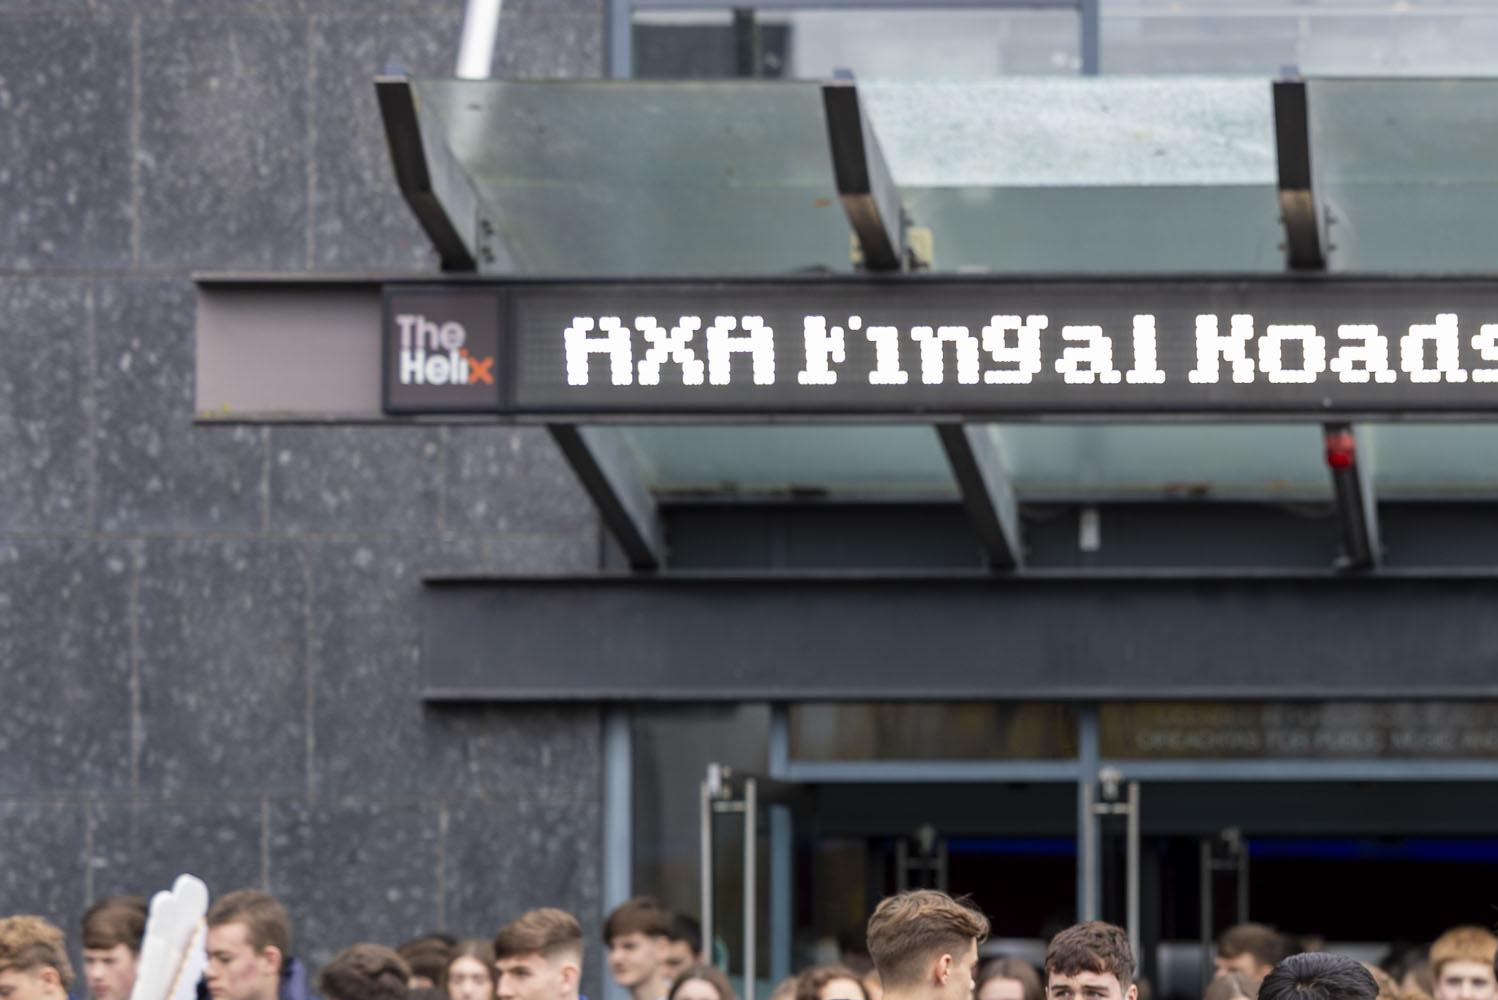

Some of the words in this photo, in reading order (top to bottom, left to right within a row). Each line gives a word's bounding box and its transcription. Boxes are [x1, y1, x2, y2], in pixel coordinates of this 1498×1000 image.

[396, 314, 466, 350] The
[563, 315, 776, 386] AXA
[400, 347, 495, 386] Helix
